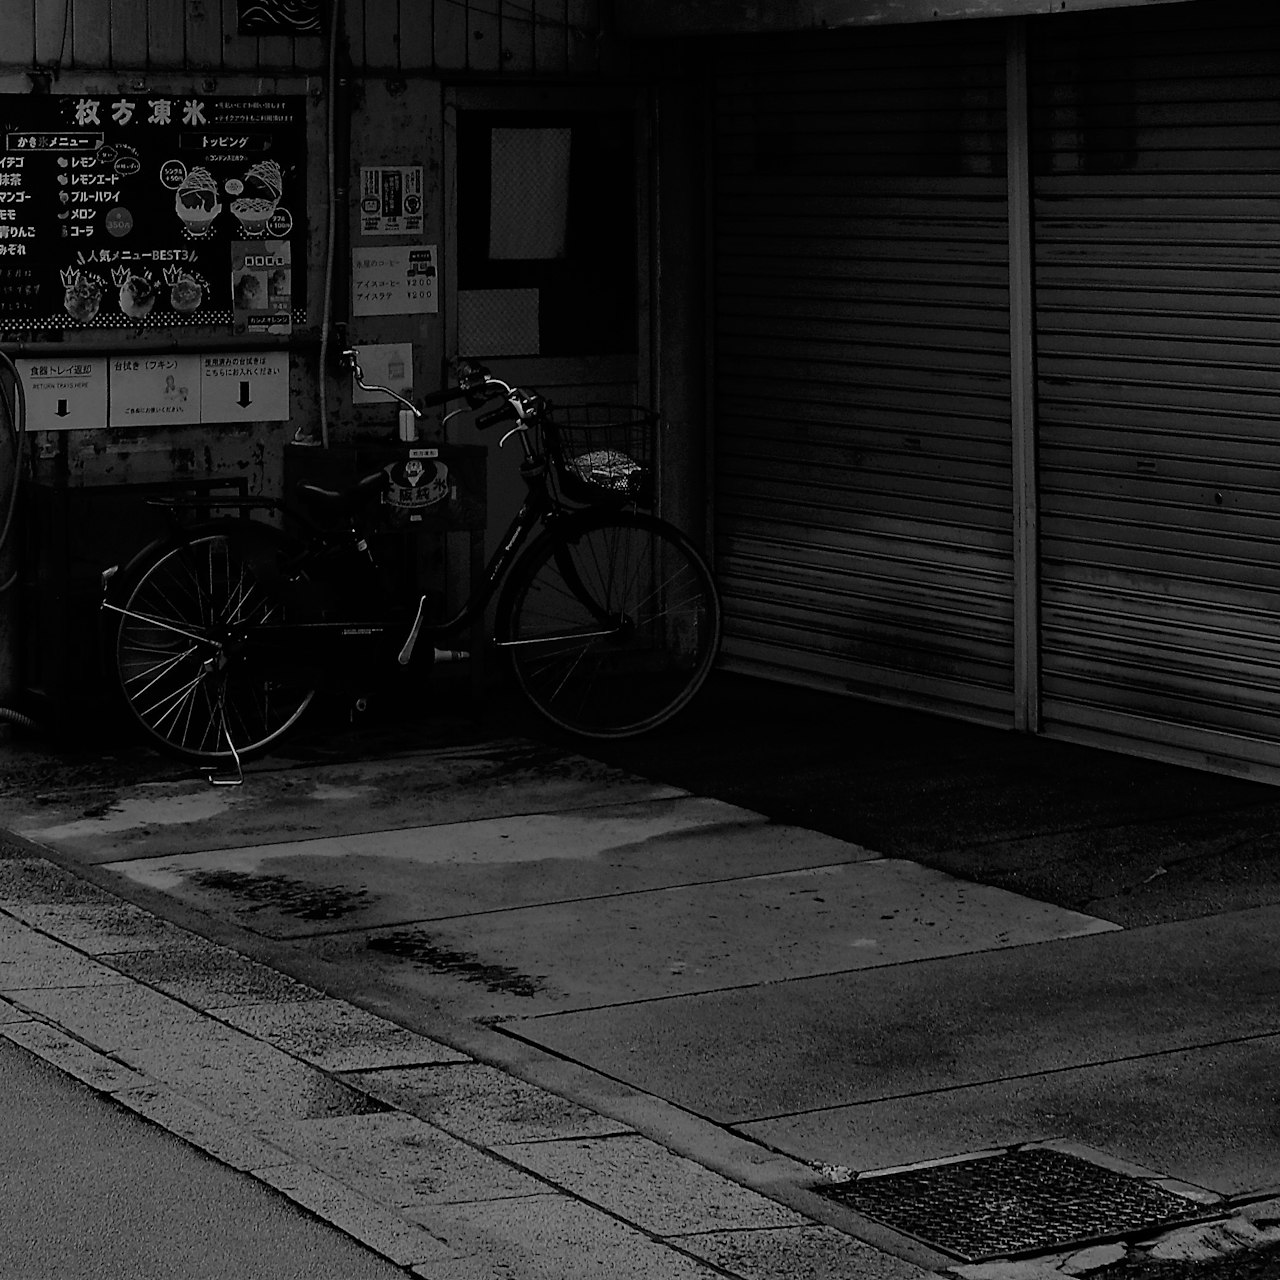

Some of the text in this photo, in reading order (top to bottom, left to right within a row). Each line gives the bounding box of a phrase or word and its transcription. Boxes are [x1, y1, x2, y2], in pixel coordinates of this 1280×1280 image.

[75, 98, 207, 126] 枚方凍氷
[17, 136, 89, 148] かき氷メニュー
[202, 136, 249, 148] トッピング
[71, 156, 96, 168] レモン
[71, 173, 119, 185] レモンエード
[71, 190, 121, 202] ブルーハワイ
[71, 208, 97, 220] メロン
[71, 225, 95, 238] コーラ
[87, 249, 189, 262] 人気メニューBEST3
[356, 280, 401, 288] アイスコーヒー
[30, 365, 92, 376] 食器トレイ返却
[205, 367, 281, 376] こちらにお入れください
